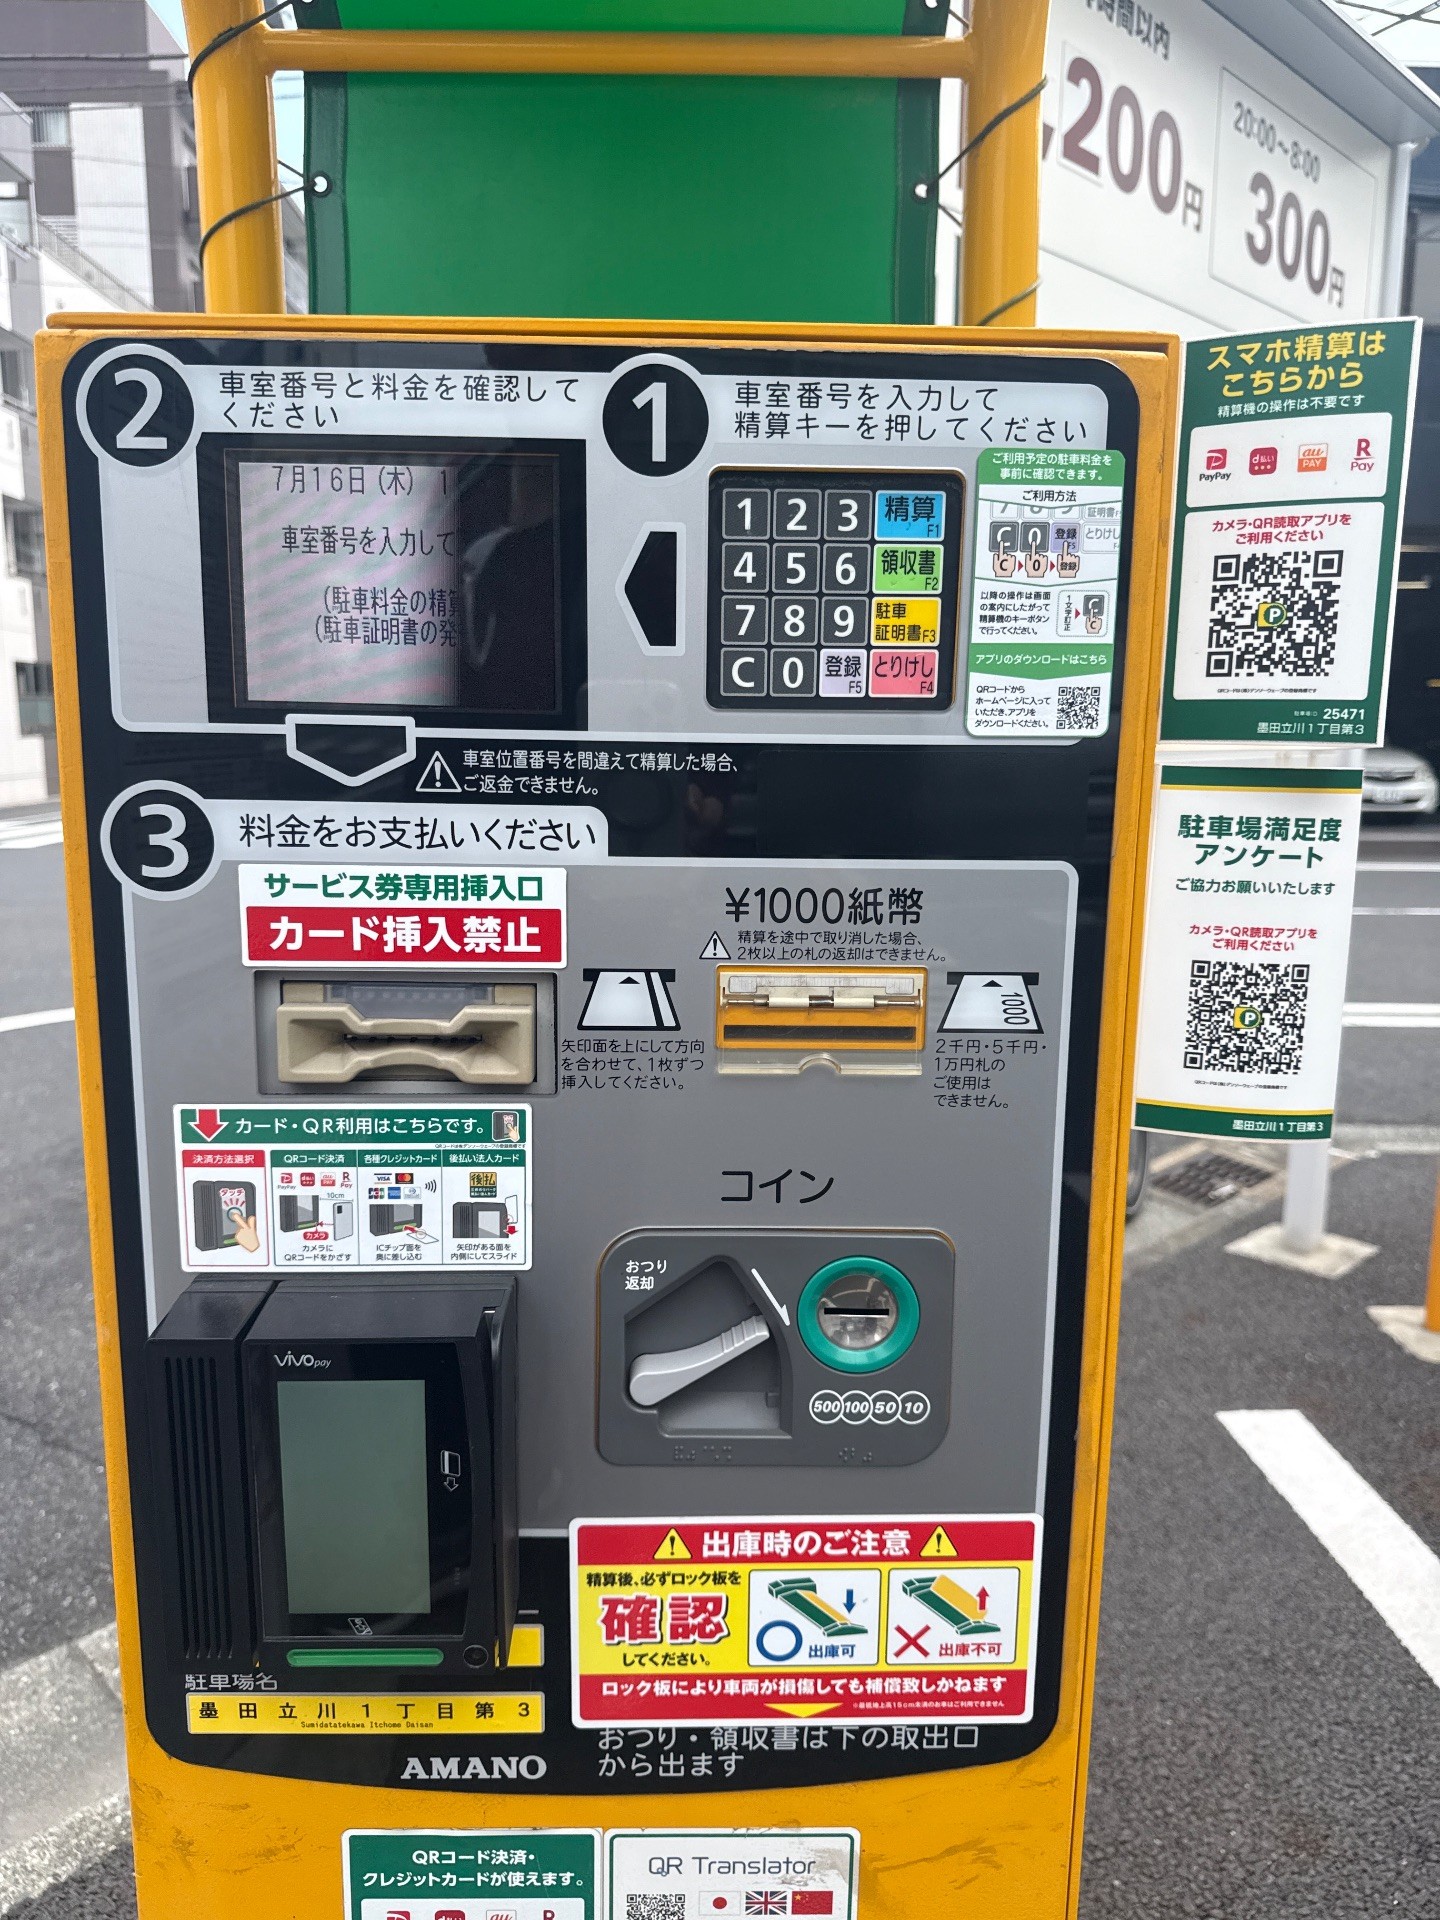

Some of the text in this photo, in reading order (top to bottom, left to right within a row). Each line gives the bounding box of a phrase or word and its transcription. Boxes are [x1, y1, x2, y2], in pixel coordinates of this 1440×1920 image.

[1245, 172, 1346, 308] 300円
[1207, 330, 1386, 371] スマホ精算は
[219, 371, 579, 402] 車室番号と料金を確認して
[1222, 362, 1364, 397] こちらから
[735, 381, 999, 411] 車室番号を入力して
[112, 367, 168, 450] 2
[221, 401, 340, 427] ください
[1217, 394, 1365, 418] 精算機の操作は不要です
[632, 381, 667, 463] 1
[734, 411, 1088, 444] 精算キーを押してください
[1302, 448, 1323, 457] au
[1356, 438, 1371, 457] R
[992, 452, 1112, 466] ご利用予定の駐車料金を
[1252, 454, 1275, 464] d払い
[1302, 458, 1323, 468] PAY
[1350, 461, 1374, 473] Pay
[1000, 468, 1103, 481] 事前に確認できます。
[1199, 471, 1232, 482] PayPay
[1022, 490, 1077, 502] ご利用方法
[737, 498, 858, 531] 1 2 3
[884, 496, 936, 522] 精算
[1212, 514, 1352, 532] カメラ・QR読取アプリを
[927, 525, 940, 538] F1
[1055, 528, 1077, 540] 登録
[1235, 530, 1324, 545] ご利用ください
[281, 525, 455, 557] 車室番号を入力して
[733, 551, 856, 585] 4 5 6
[881, 549, 936, 576] 領収書
[999, 559, 1077, 572] C 0 登録
[925, 577, 938, 591] F2
[980, 591, 1051, 601] 以降の操作は画面
[875, 603, 907, 619] 駐車
[979, 603, 1050, 612] の案内にしたがって
[735, 604, 854, 638] 7 8 9
[979, 614, 1050, 624] 精算機のキーボタン
[875, 624, 936, 643] 証明書 F3
[979, 626, 1038, 635] で行ってください。
[825, 655, 862, 678] 登録
[874, 655, 933, 678] とりけし
[975, 654, 1107, 665] アプリのダウンロードはこちら
[732, 656, 804, 688] C 0
[849, 681, 862, 694] F5
[920, 681, 934, 695] F4
[976, 685, 1026, 694] QRコードから
[975, 697, 1051, 706] ホームページに入って
[974, 708, 1036, 717] いただき、アプリを
[1323, 708, 1365, 720] 25471
[974, 719, 1049, 728] ダウンロードください。
[1256, 722, 1365, 735] 墨田立川1丁目第3
[462, 748, 739, 773] 車室位置番号を間違えて精算した場合、
[463, 774, 600, 796] ご返金できません。
[239, 812, 596, 853] 料金をお支払いください
[1177, 814, 1343, 842] 駐車場満足度
[138, 803, 190, 878] 3
[1195, 843, 1324, 869] アンケート
[264, 873, 544, 902] サービス券専用挿入口
[1175, 878, 1336, 896] ご協力お願いいたします
[725, 886, 925, 926] ¥1000紙幣
[270, 916, 541, 954] カード挿入禁止
[737, 930, 922, 946] 精算を途中で取り消した場合、
[1189, 924, 1318, 939] カメラ・QR読取アプリを
[1212, 939, 1295, 951] ご利用ください
[737, 946, 947, 962] 2枚以上の札の返却はできません。
[1000, 992, 1031, 1026] 1000
[561, 1038, 705, 1054] 矢印面を上にして方向
[935, 1039, 1047, 1054] 2千円・5千円・
[560, 1056, 704, 1073] を合わせて、1枚ずつ
[935, 1057, 1006, 1073] 1万円札の
[561, 1074, 685, 1090] 挿入してください。
[933, 1075, 991, 1091] ご使用は
[933, 1093, 1010, 1109] できません。
[236, 1117, 484, 1135] カード・QR利用はこちらです。
[1232, 1119, 1324, 1133] 墨田立川1丁目第3
[192, 1154, 255, 1165] 決済方法選択
[283, 1154, 345, 1164] QRコード決済
[363, 1153, 438, 1164] 各種クレジットカード
[449, 1153, 520, 1164] 後払い法人カード
[219, 1188, 245, 1197] タッチ
[720, 1169, 834, 1203] コイン
[302, 1244, 334, 1252] カメラに
[376, 1243, 422, 1251] ICチップ面を
[457, 1243, 511, 1251] 矢印がある面を
[284, 1253, 352, 1261] QRコードをかざす
[376, 1252, 422, 1261] 奥に差し込む
[451, 1252, 518, 1261] 内側にしてスライド
[625, 1259, 667, 1274] おつり
[624, 1275, 655, 1291] 返却
[813, 1401, 924, 1414] 500 100 50 10
[701, 1528, 910, 1559] 出庫時のご注意
[586, 1570, 742, 1587] 精算後、必ずロック板を
[599, 1593, 730, 1646] 確認
[808, 1643, 856, 1659] 出庫可
[938, 1642, 1002, 1658] 出庫不可
[622, 1652, 711, 1668] してください。
[185, 1673, 278, 1691] 駐車場名
[602, 1675, 1008, 1697] ロック板により車両が損傷しても補償致しかねます
[300, 1721, 434, 1729] Sumidatatekawa Itchome Daisan
[598, 1724, 979, 1751] おつり・領収書は下の取出口
[400, 1754, 547, 1780] AMANO
[598, 1752, 744, 1778] から出ます
[412, 1849, 535, 1866] QRコード決済・
[648, 1856, 815, 1877] QR Translator
[362, 1871, 585, 1888] クレジットカードが使えます。
